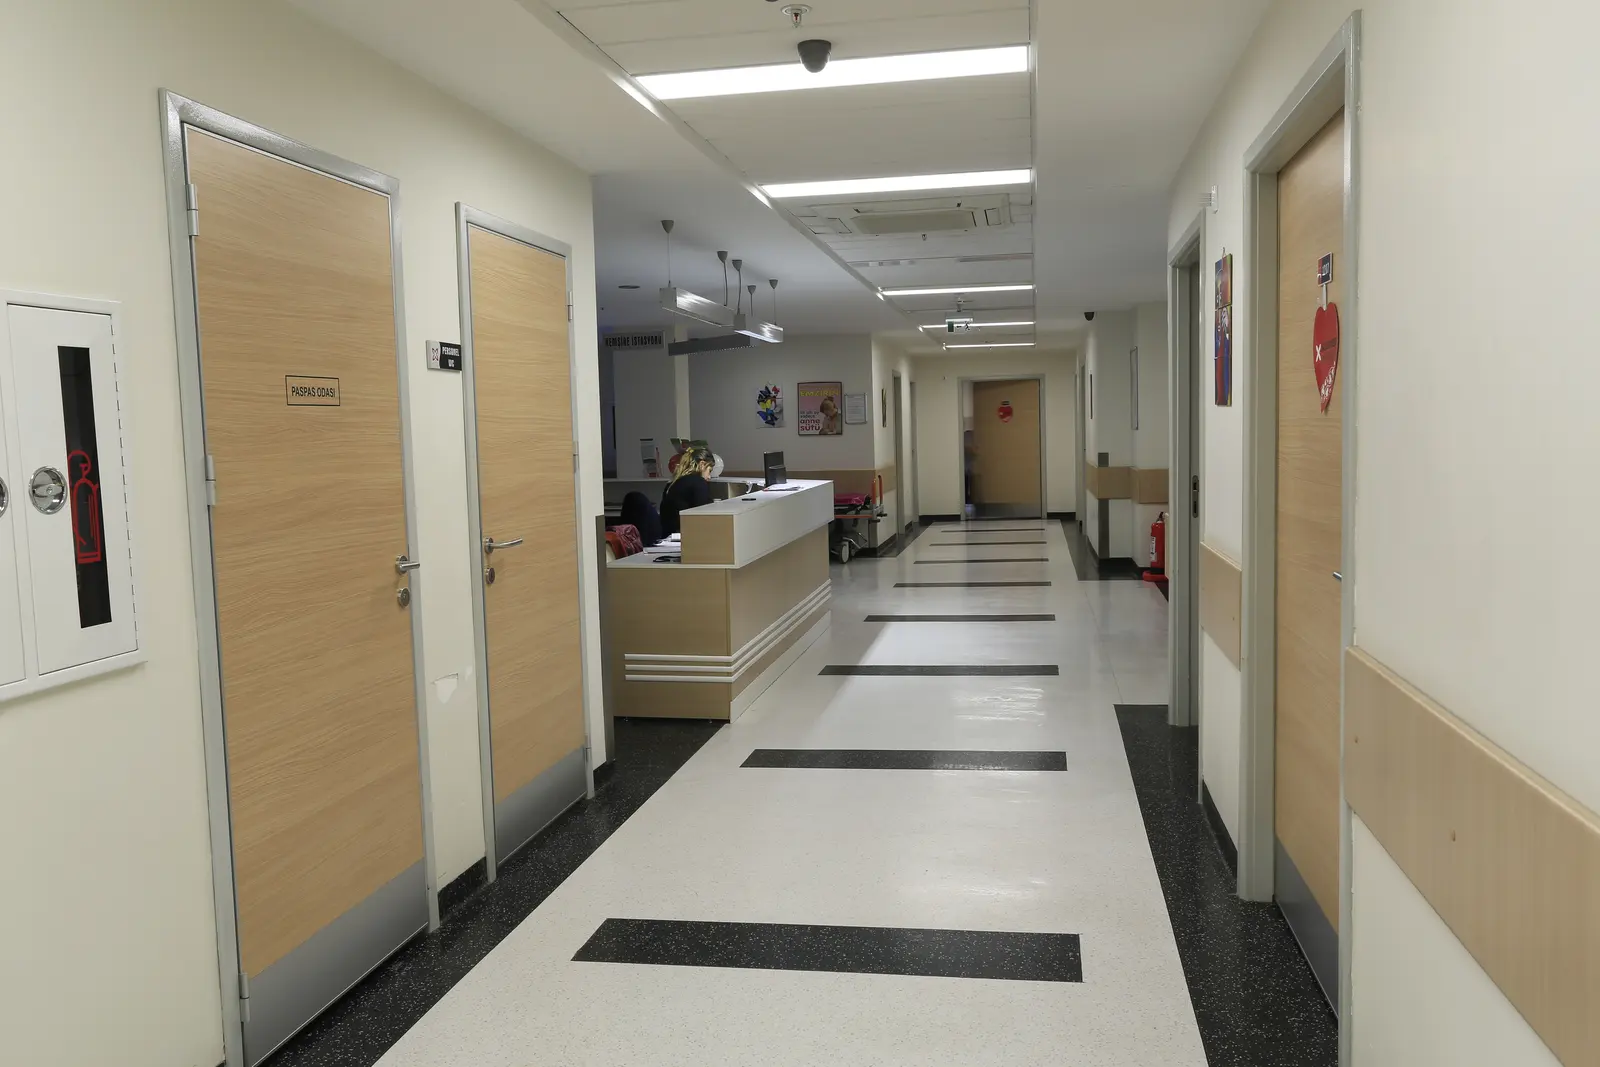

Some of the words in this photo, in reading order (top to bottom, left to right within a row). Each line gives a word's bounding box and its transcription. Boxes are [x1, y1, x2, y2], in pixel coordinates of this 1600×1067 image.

[441, 346, 460, 357] PERSONEL
[447, 358, 455, 368] WC
[291, 386, 316, 397] PASPAS
[316, 387, 336, 398] ODASI
[800, 423, 820, 431] sütü
